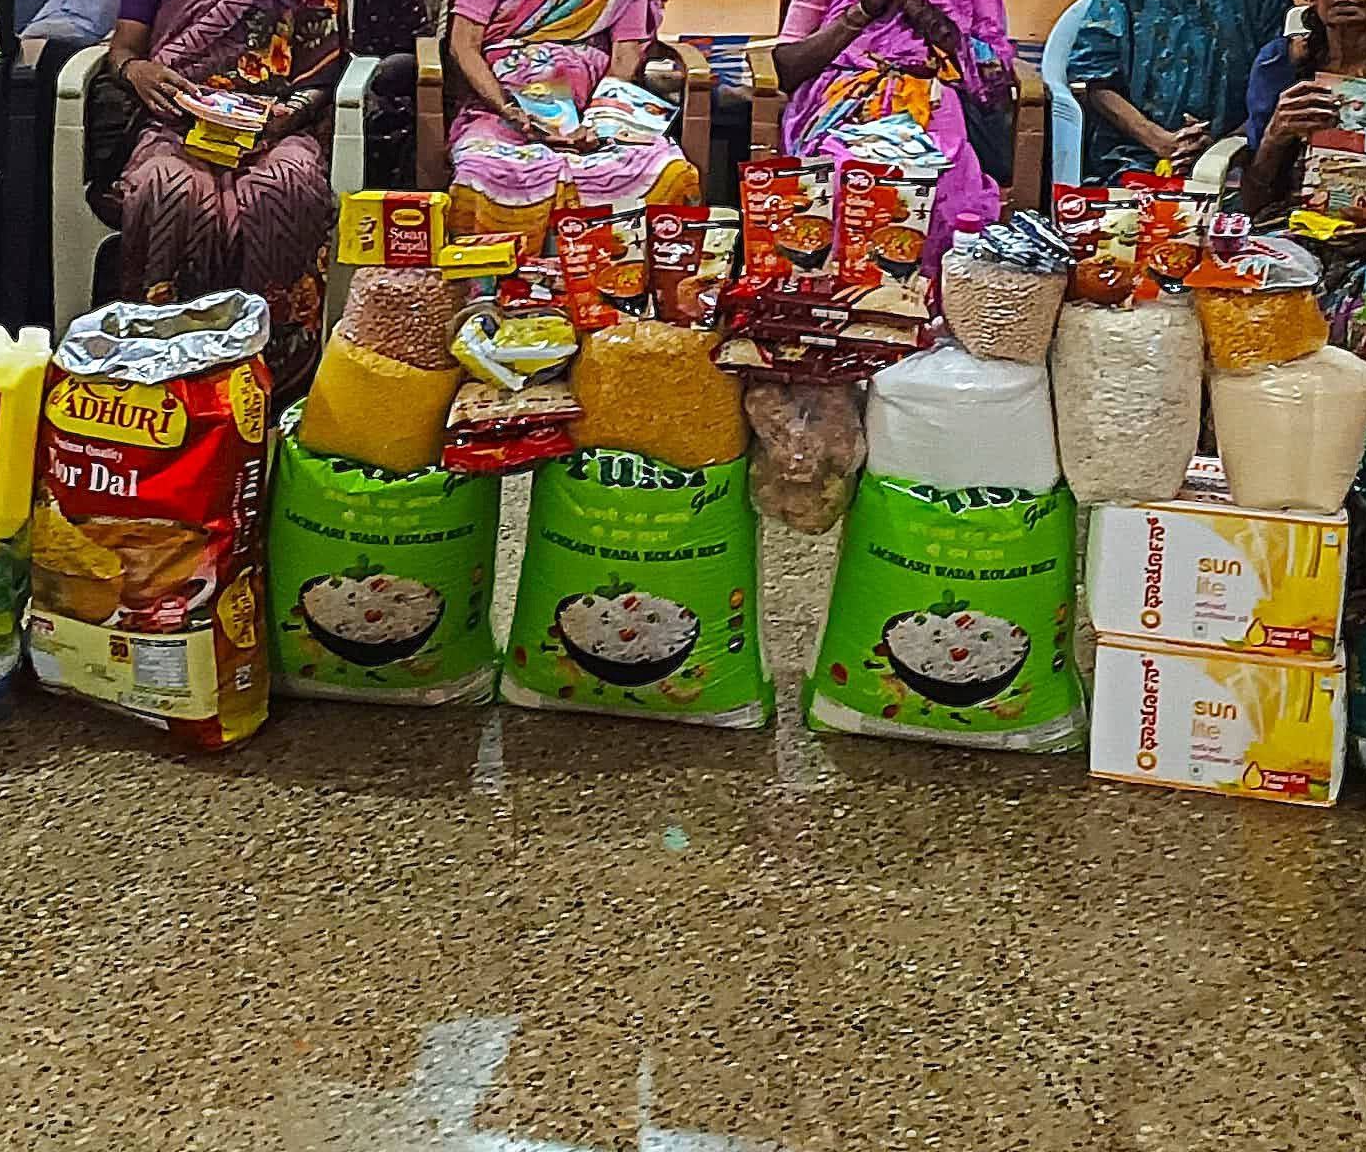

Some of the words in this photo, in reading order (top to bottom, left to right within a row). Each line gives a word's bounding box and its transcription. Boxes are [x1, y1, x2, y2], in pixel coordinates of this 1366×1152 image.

[88, 463, 138, 497] Dal
[1198, 556, 1242, 576] sun
[1196, 576, 1227, 597] lite
[1194, 700, 1237, 720] sun
